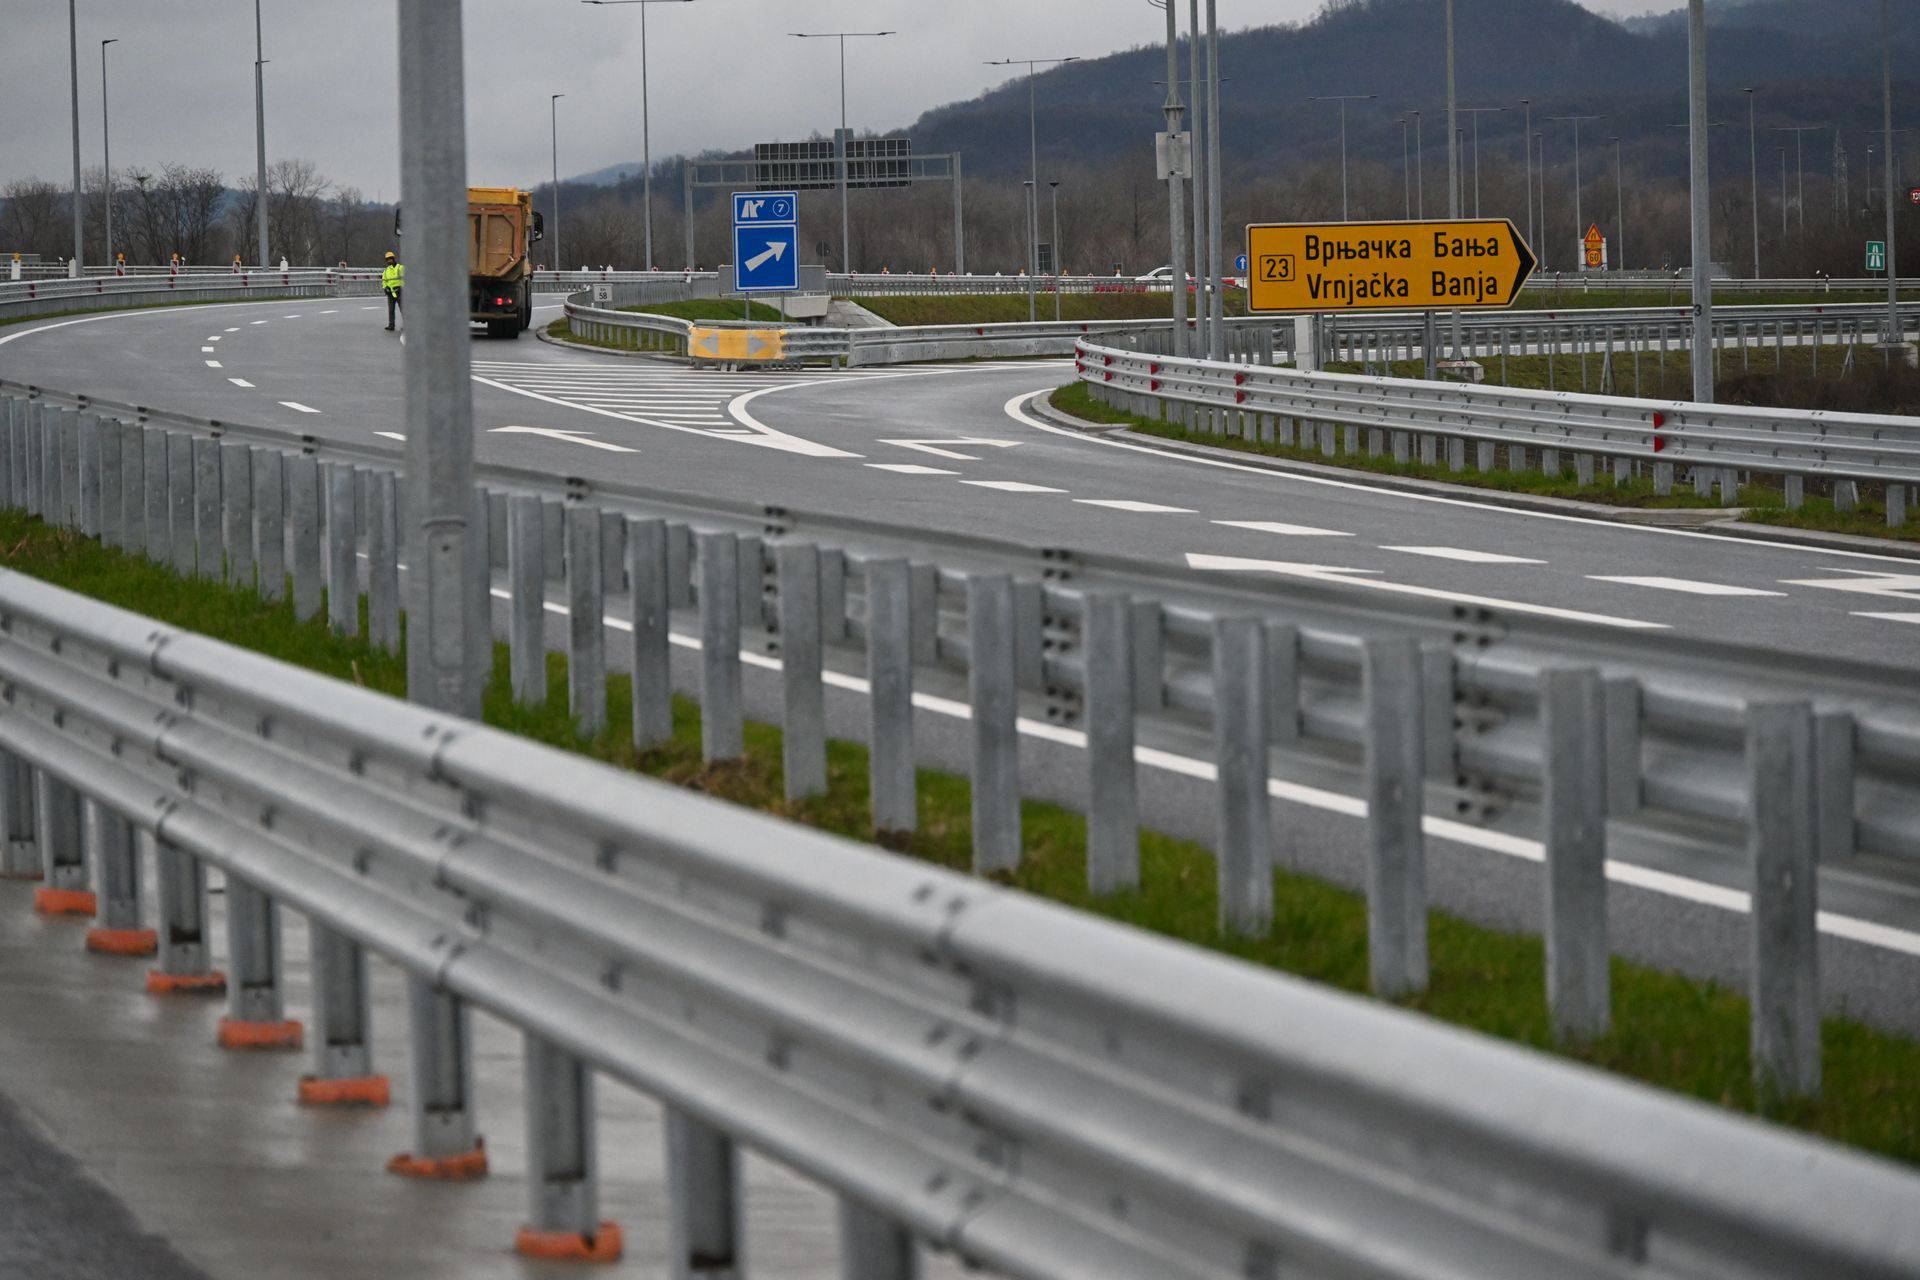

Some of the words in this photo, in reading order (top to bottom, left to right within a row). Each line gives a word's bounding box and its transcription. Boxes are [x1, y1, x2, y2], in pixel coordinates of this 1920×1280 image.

[778, 203, 785, 213] 7
[1305, 234, 1411, 267] Врњачка
[1434, 231, 1499, 257] Бања
[1590, 252, 1599, 262] 60
[1266, 258, 1289, 278] 23
[1306, 271, 1409, 305] Vrnjačka
[1432, 270, 1498, 302] Banja
[599, 291, 608, 300] 58
[1694, 304, 1702, 316] 3
